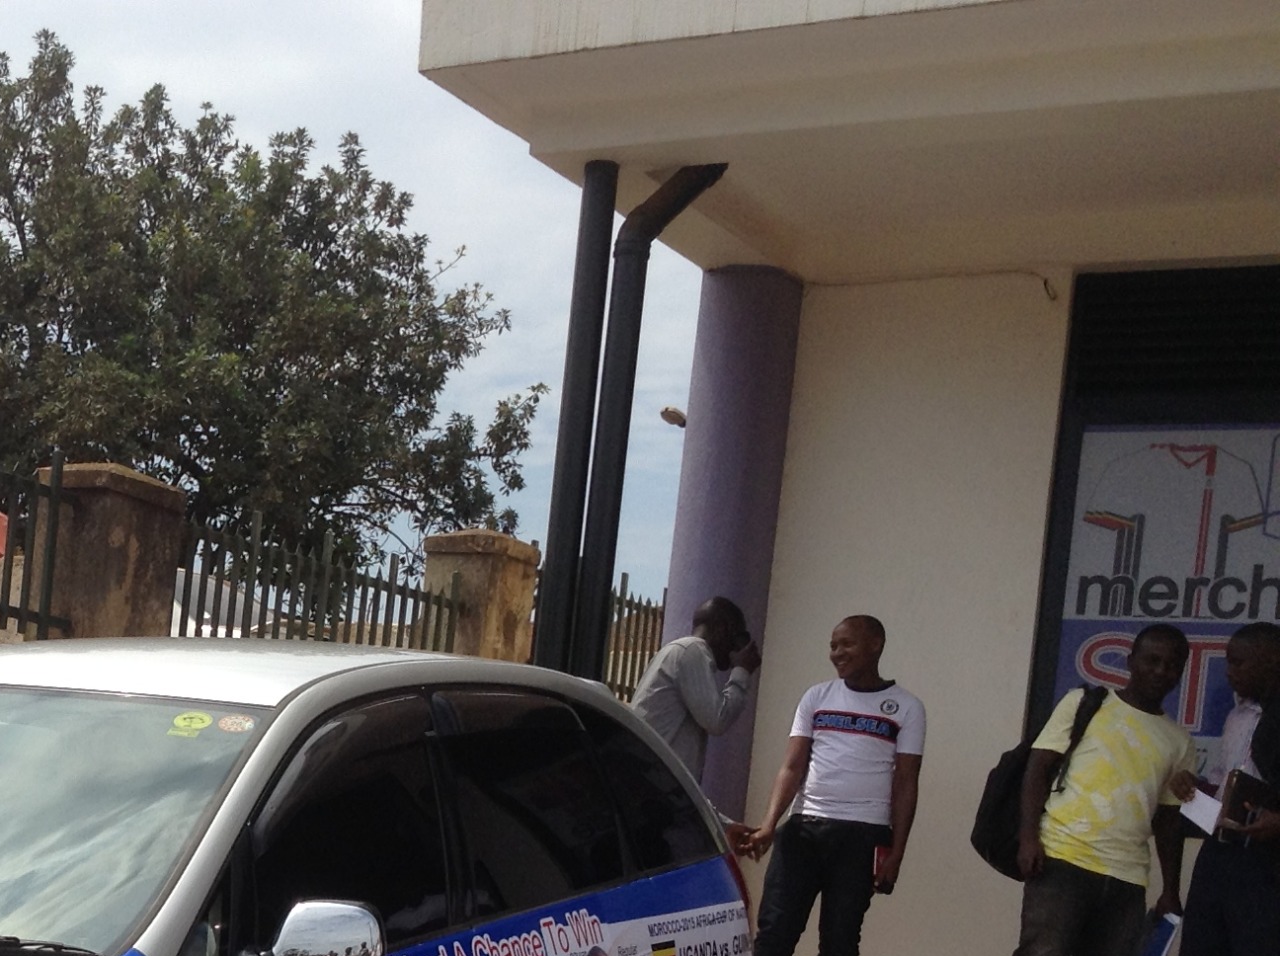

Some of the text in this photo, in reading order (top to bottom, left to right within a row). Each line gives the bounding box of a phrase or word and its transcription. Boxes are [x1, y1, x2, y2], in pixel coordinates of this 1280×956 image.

[540, 916, 570, 956] To
[566, 908, 605, 948] Win
[648, 916, 695, 937] MOROCCO-2015
